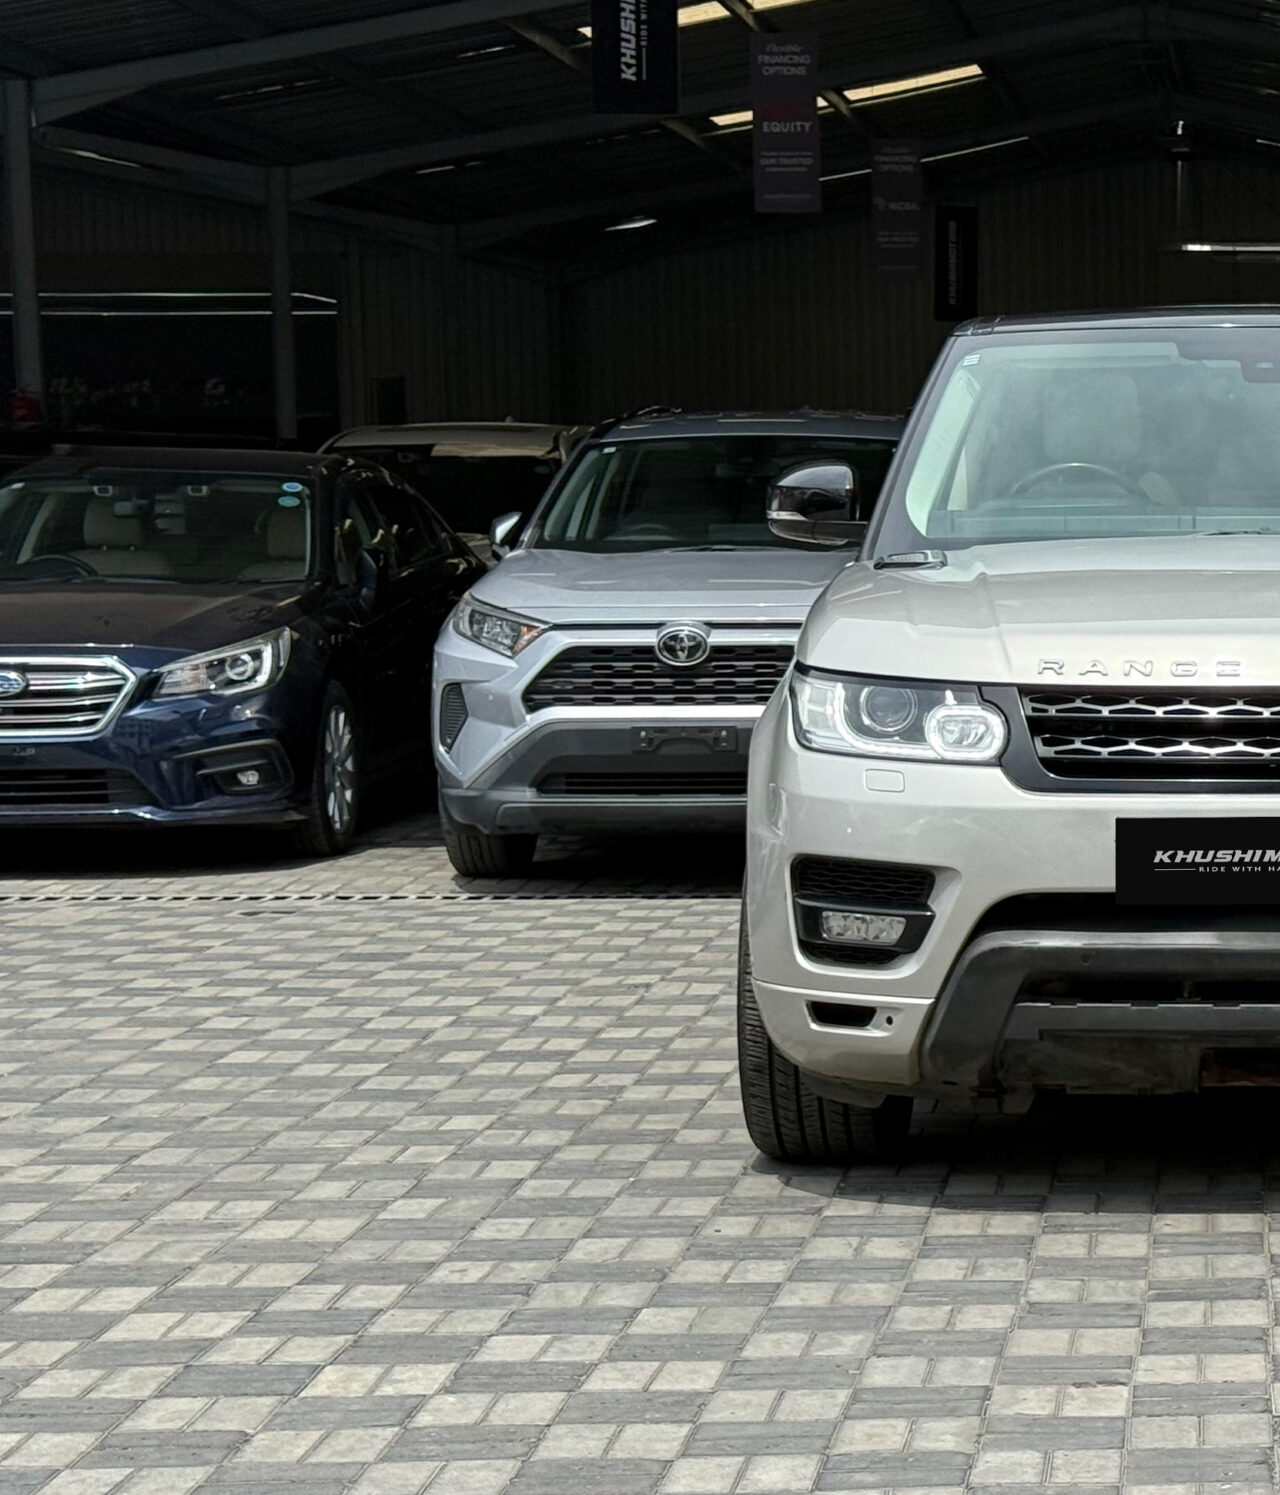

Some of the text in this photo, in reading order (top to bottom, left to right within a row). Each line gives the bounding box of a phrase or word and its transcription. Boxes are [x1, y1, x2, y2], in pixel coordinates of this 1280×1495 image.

[757, 54, 811, 64] FINANCING
[762, 65, 807, 76] OPTIONS
[762, 121, 813, 133] EQUITY
[1037, 658, 1241, 678] RANGE
